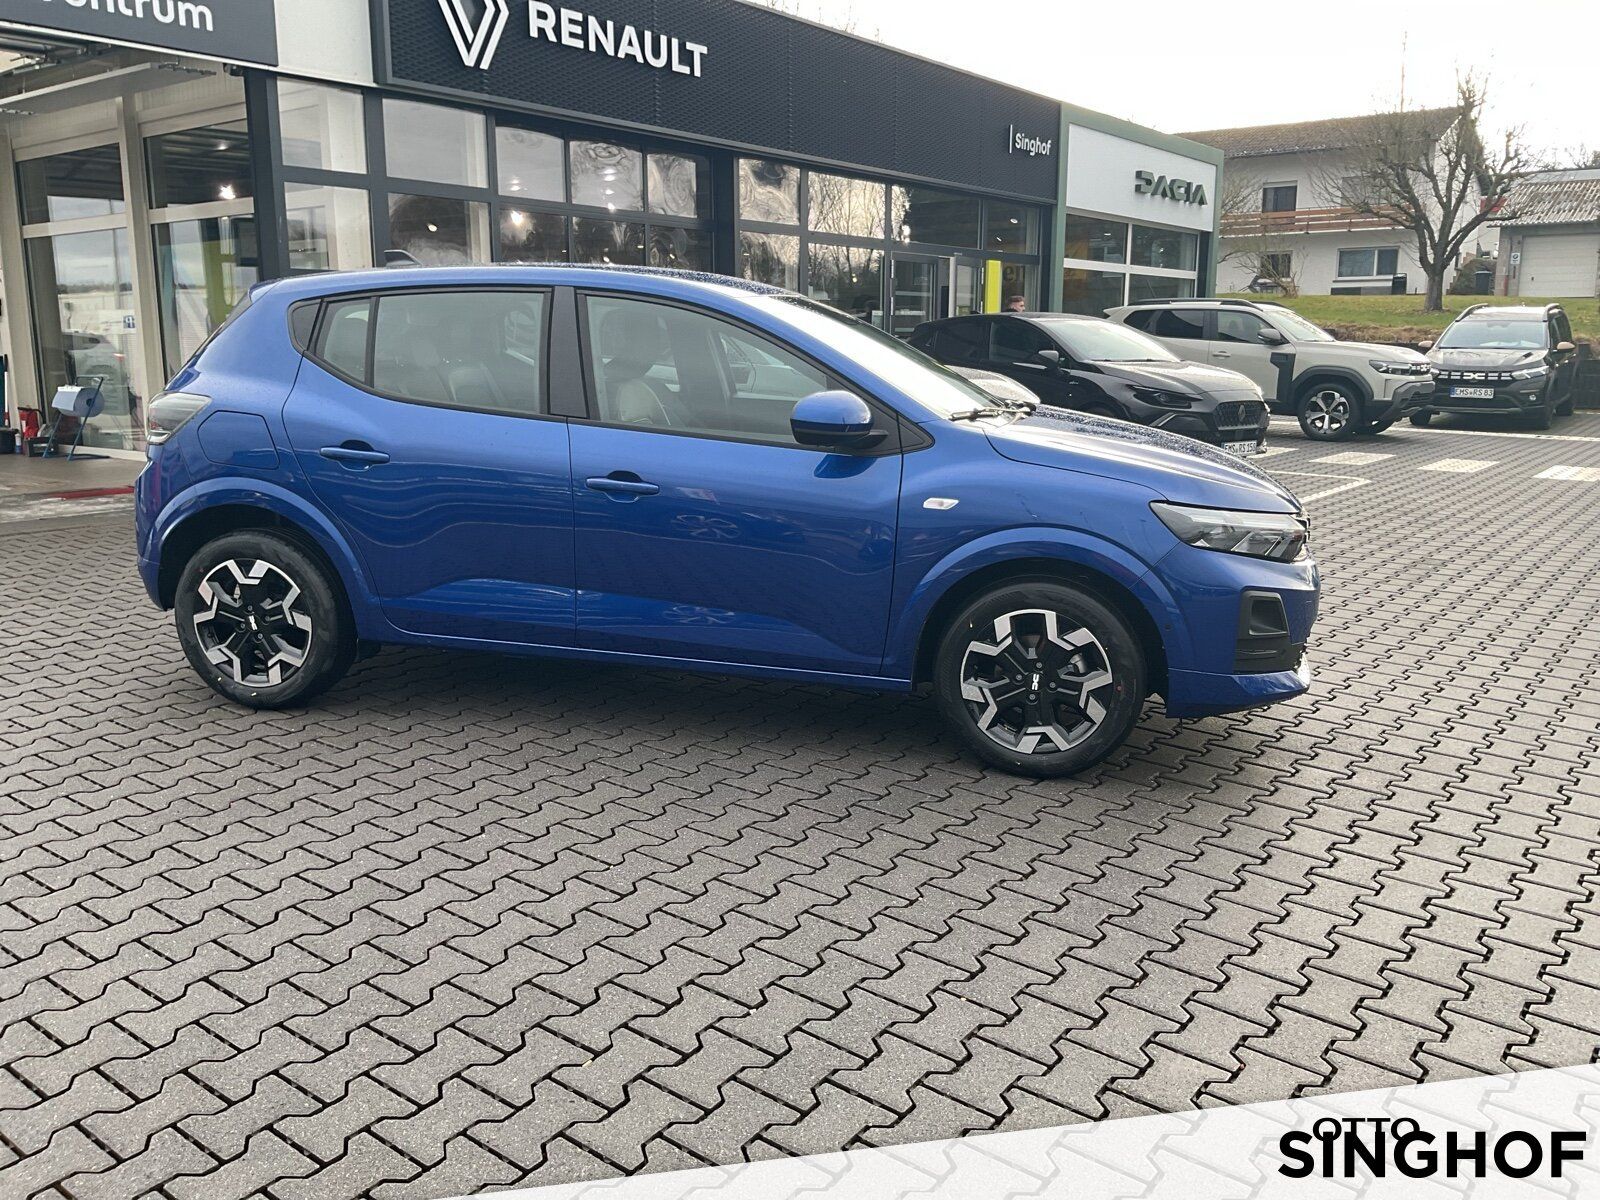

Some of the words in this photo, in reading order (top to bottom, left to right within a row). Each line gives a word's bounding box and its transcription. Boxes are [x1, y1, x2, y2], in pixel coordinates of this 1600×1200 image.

[43, 0, 213, 31] trum
[528, 0, 708, 77] RENAULT
[1014, 132, 1052, 156] Singhof
[1135, 170, 1208, 206] DACIA
[1484, 389, 1493, 397] 83
